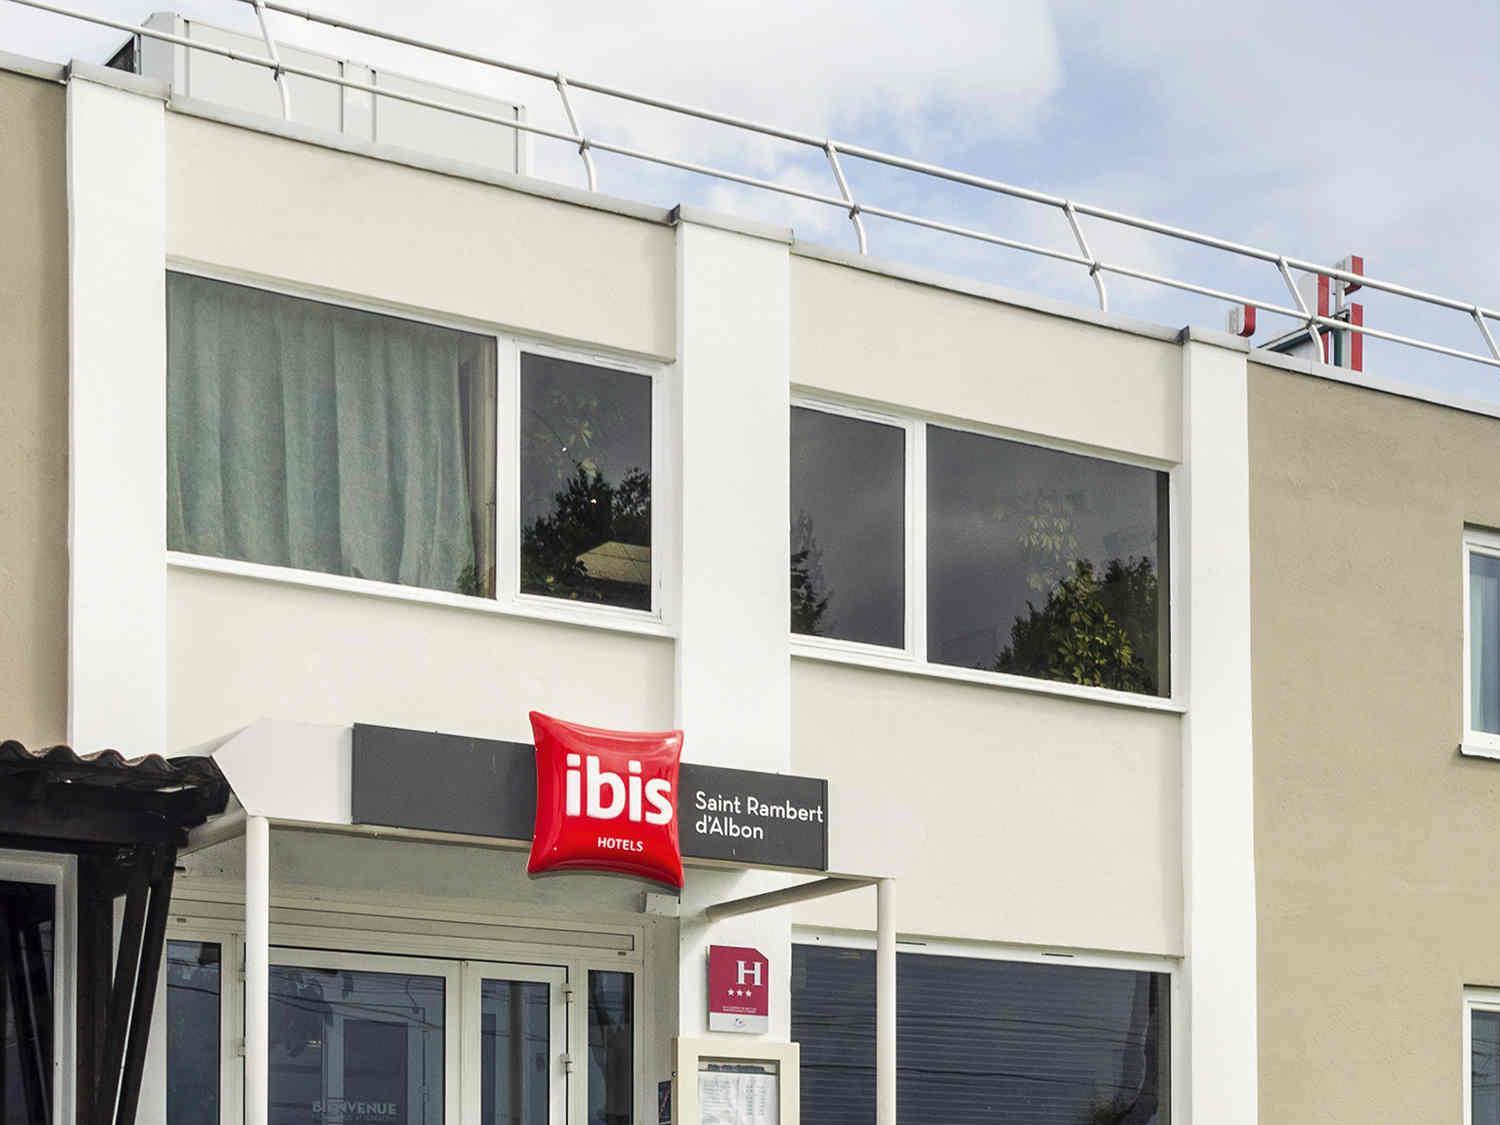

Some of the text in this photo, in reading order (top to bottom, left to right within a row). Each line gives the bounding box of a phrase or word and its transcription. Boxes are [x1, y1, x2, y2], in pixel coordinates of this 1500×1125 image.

[566, 753, 673, 826] ibis
[695, 790, 823, 823] Saint Rambert
[695, 814, 764, 839] d'Albon
[597, 836, 644, 852] HOTELS
[736, 960, 763, 986] H
